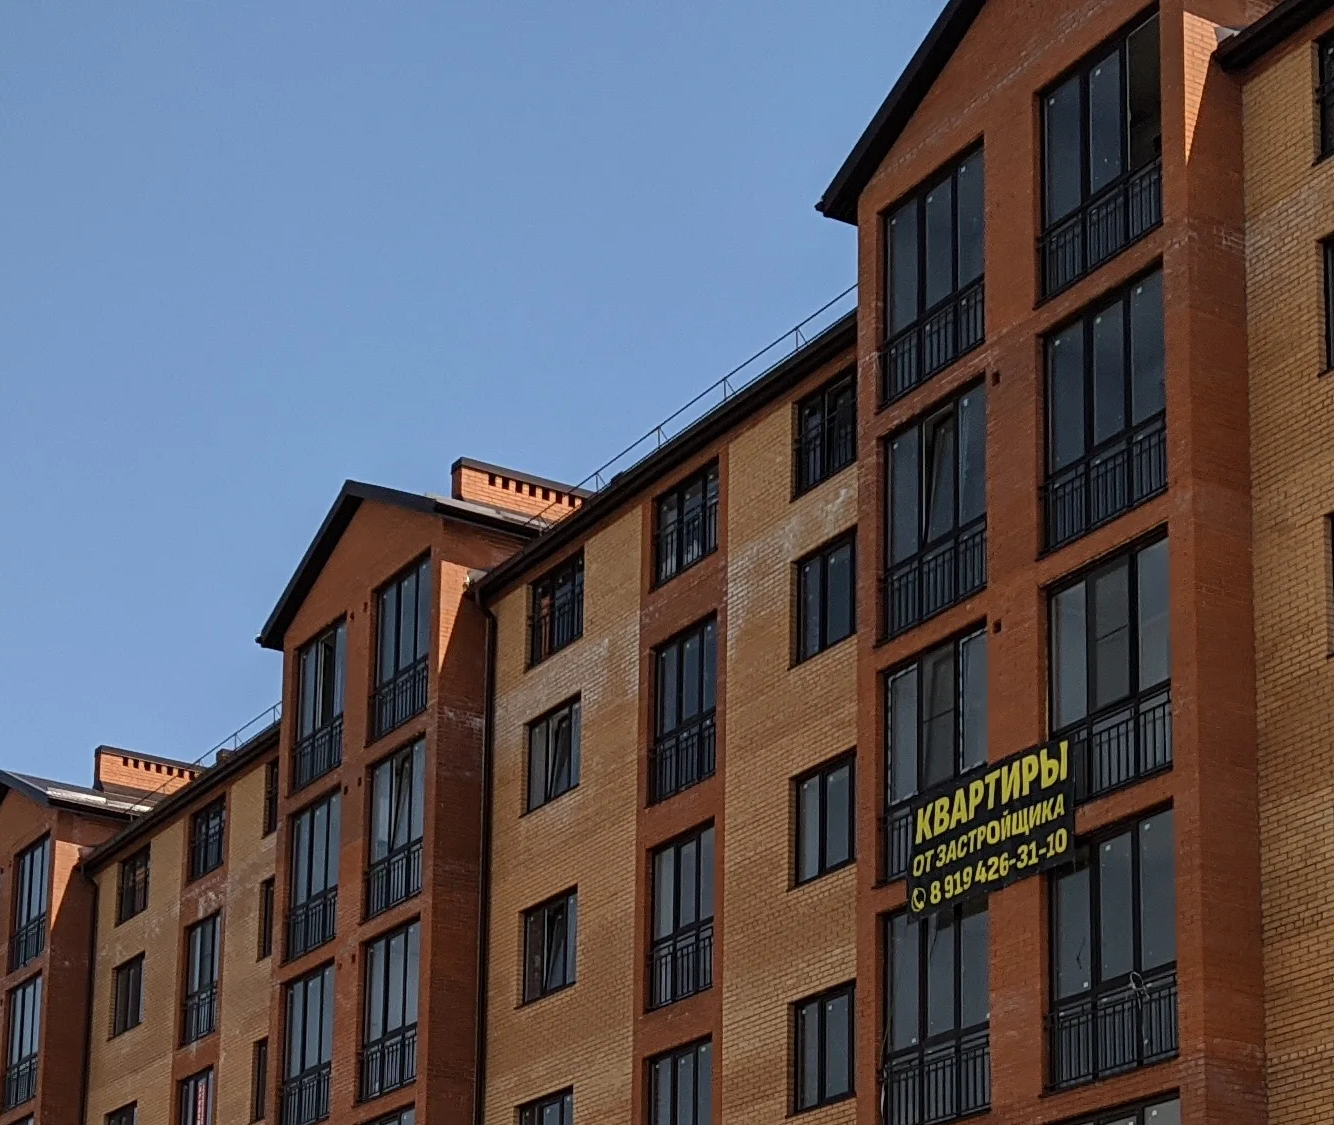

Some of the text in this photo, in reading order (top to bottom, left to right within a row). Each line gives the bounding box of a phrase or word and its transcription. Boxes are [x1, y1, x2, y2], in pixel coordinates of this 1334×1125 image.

[915, 739, 1068, 845] КВАРТИРЫ
[913, 793, 1065, 877] ОТ ЗАСТРОЙЩИКА
[930, 827, 1068, 904] 8 919 426-31-10
